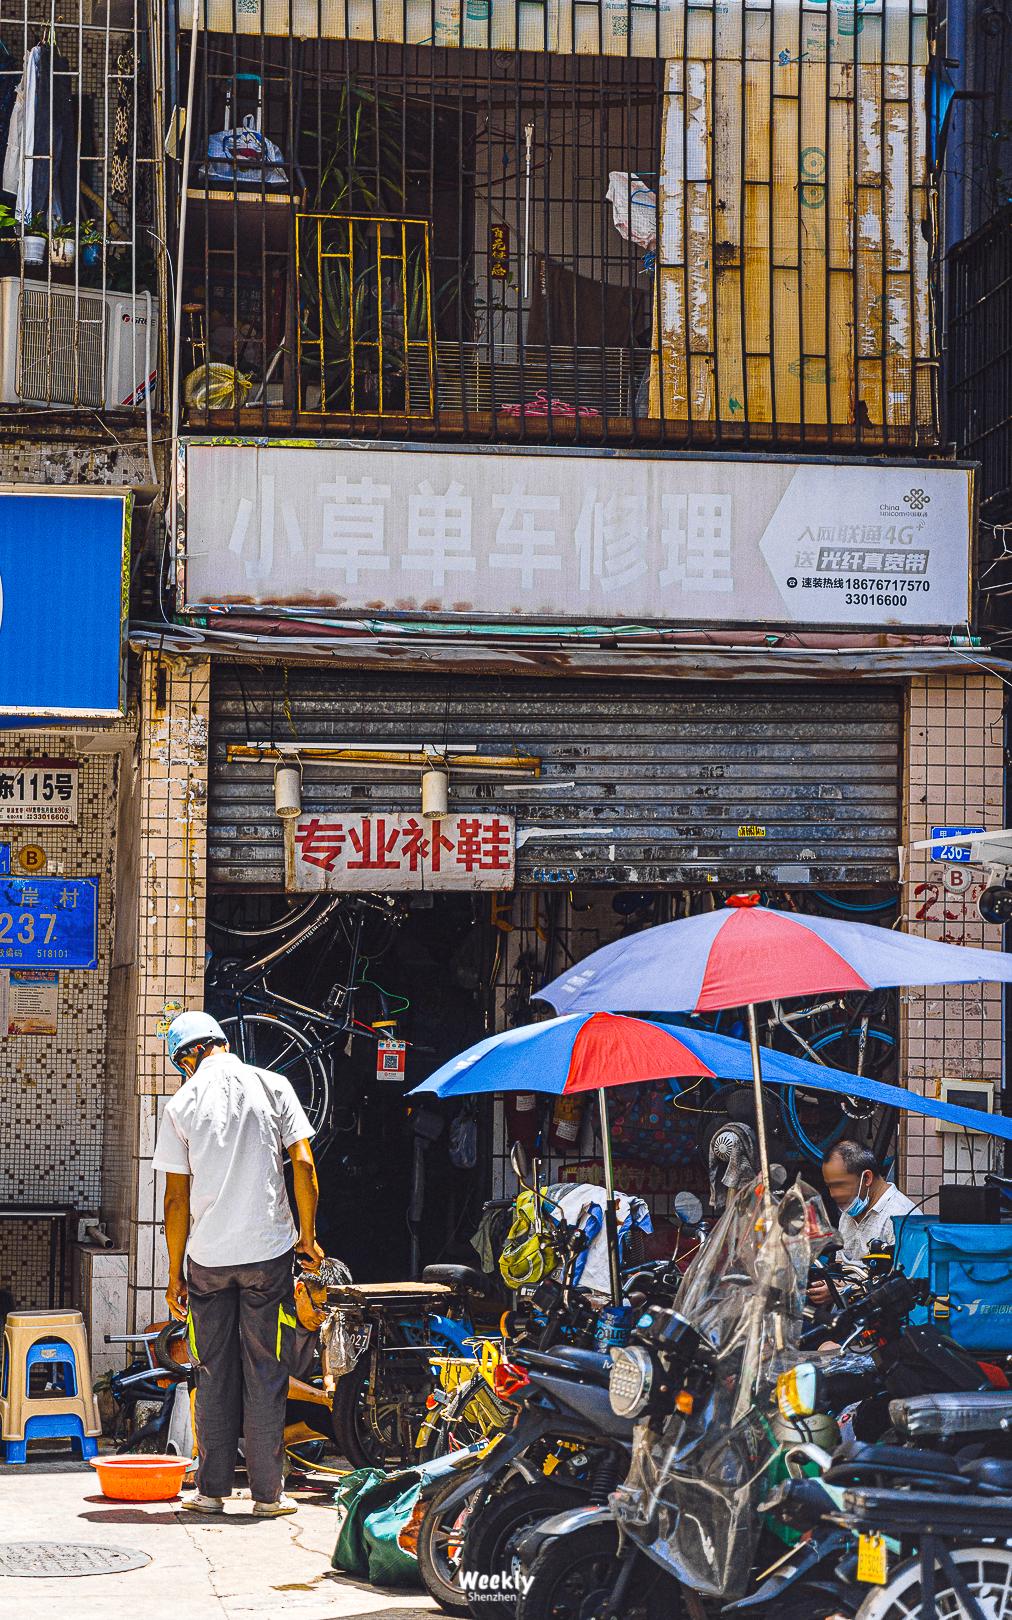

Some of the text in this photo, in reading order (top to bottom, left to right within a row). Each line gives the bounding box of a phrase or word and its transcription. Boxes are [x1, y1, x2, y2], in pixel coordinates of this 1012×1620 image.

[879, 503, 900, 511] China
[229, 475, 734, 592] 小草单车修理
[845, 578, 930, 592] 18676717570
[845, 593, 907, 606] 33016600
[294, 817, 511, 873] 专业补鞋
[26, 850, 38, 865] B
[950, 870, 964, 886] B
[37, 949, 68, 958] 518101
